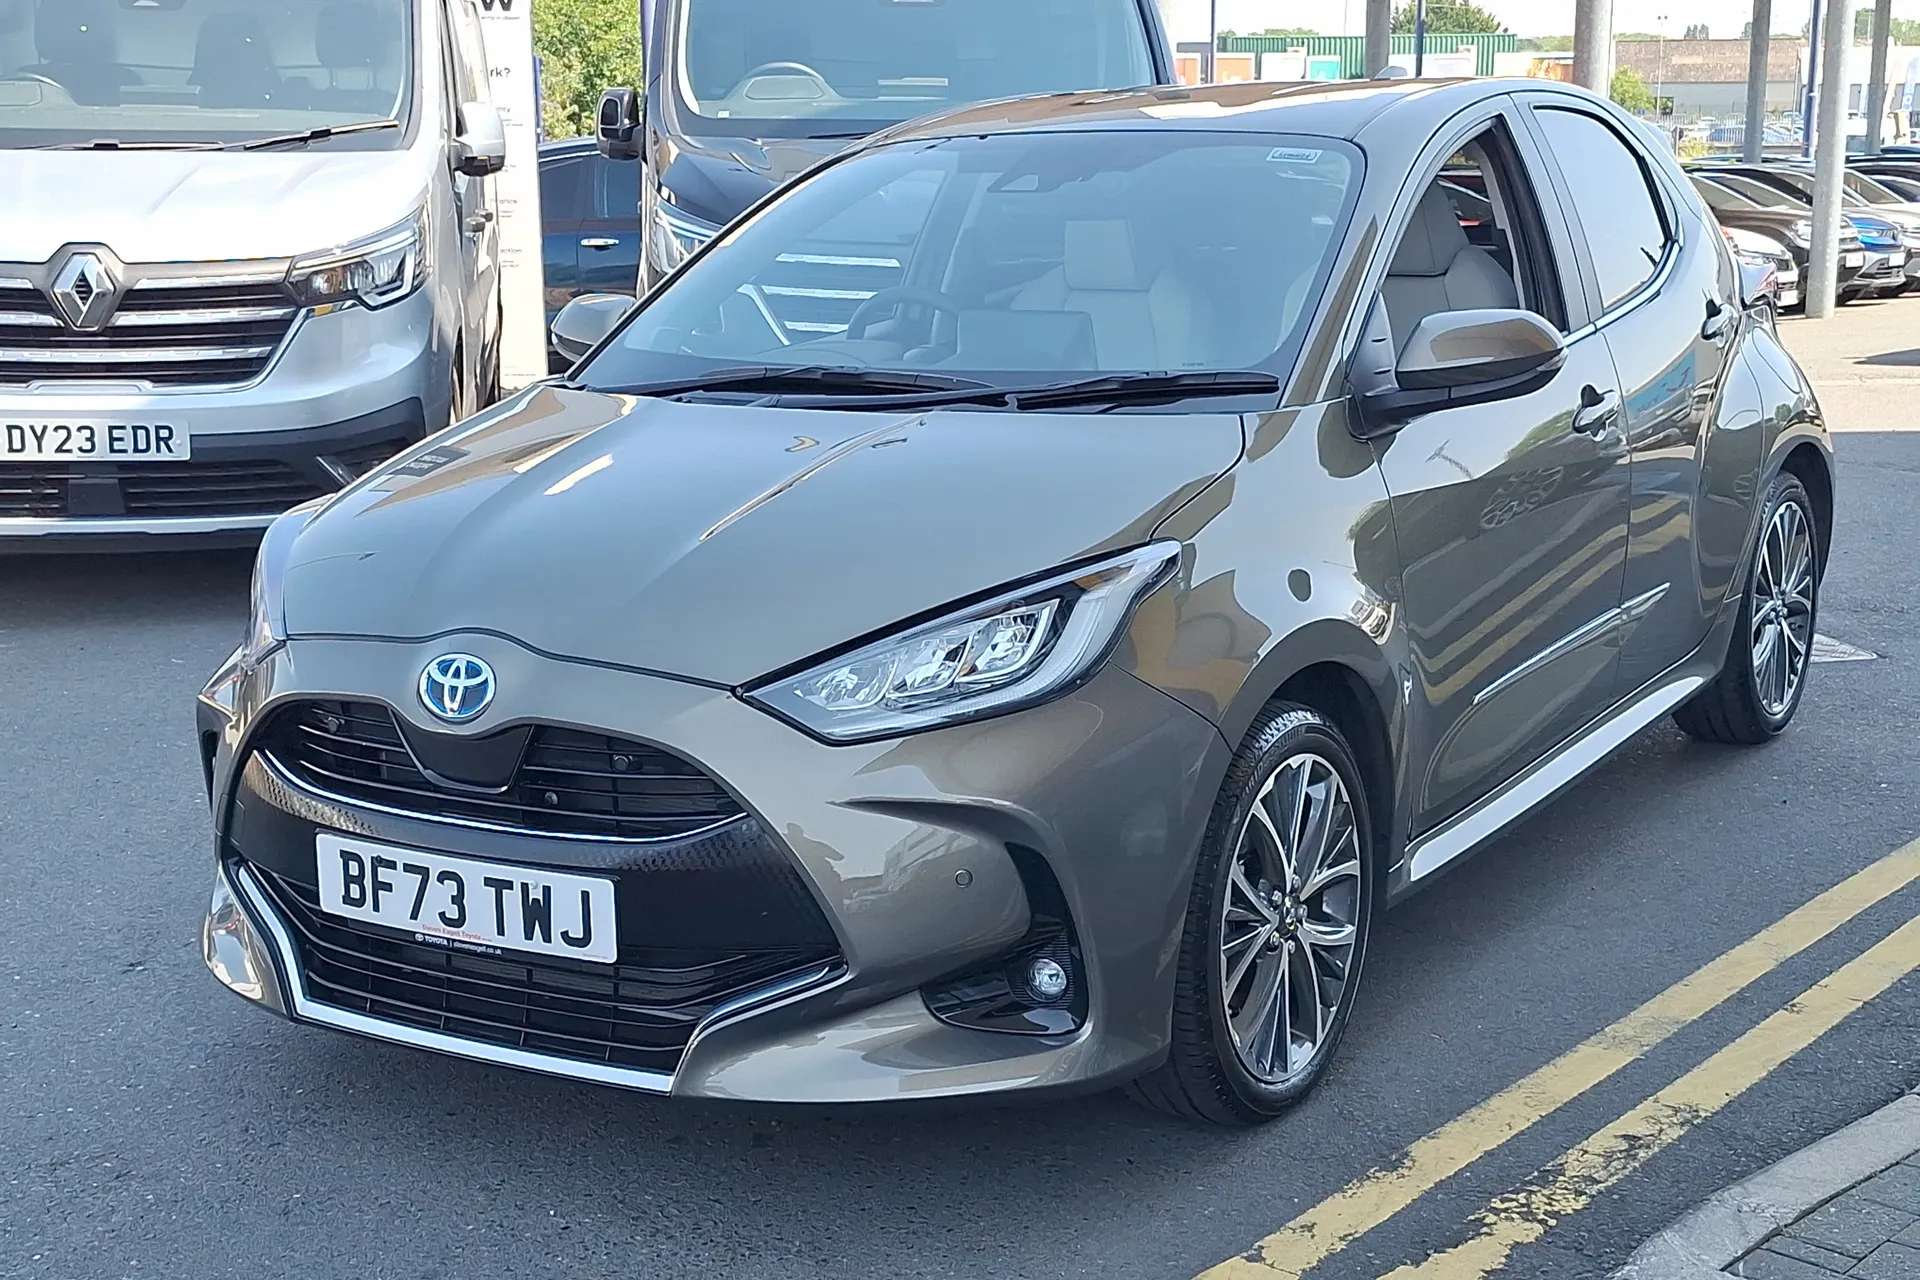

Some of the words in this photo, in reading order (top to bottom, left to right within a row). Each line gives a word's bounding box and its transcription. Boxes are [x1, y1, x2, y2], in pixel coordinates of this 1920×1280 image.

[489, 67, 511, 77] rk?
[6, 425, 96, 453] DY23
[108, 425, 175, 453] EDR
[339, 848, 468, 929] BF73
[484, 876, 592, 949] TWJ
[424, 935, 449, 946] TOYOTA
